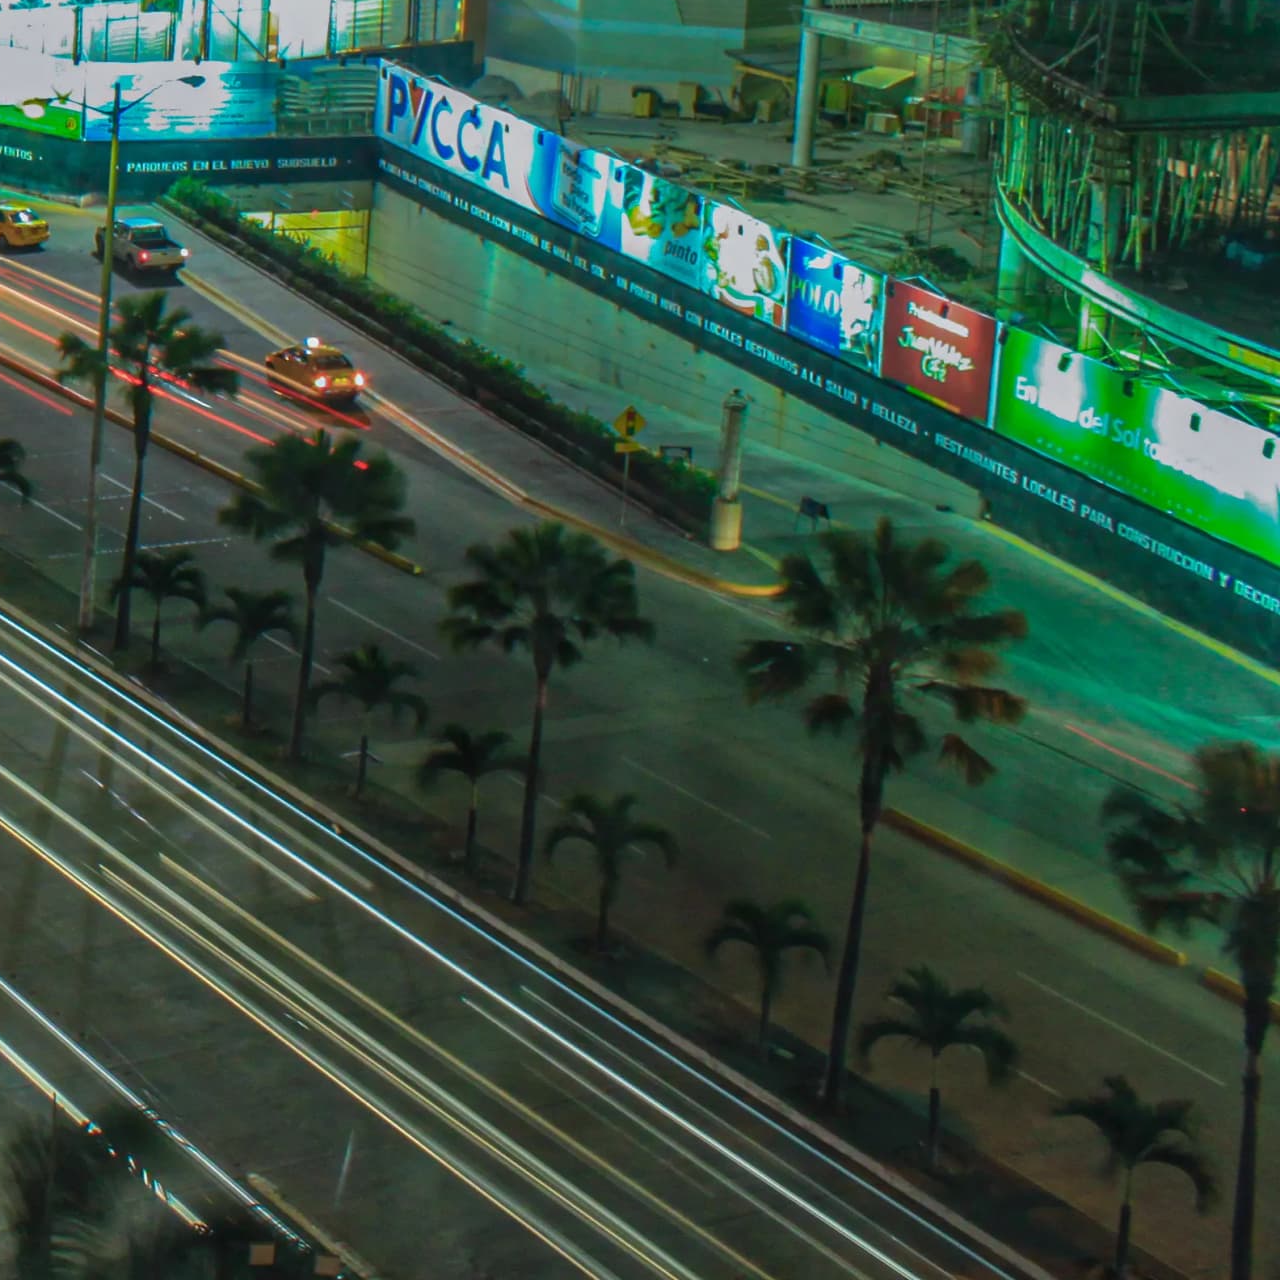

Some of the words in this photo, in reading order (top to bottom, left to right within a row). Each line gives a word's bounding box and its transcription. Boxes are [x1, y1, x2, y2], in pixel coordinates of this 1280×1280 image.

[385, 71, 510, 190] PYCCA
[192, 160, 209, 171] EN
[212, 159, 227, 171] EL
[231, 159, 269, 170] NUEVO
[663, 238, 698, 266] pinto
[791, 273, 841, 318] POLO
[704, 316, 742, 349] LOCALES
[808, 369, 822, 389] LA
[824, 377, 856, 406] SALUD
[871, 399, 917, 436] BELLEZA
[934, 429, 1018, 486] RESTAURANTES
[1022, 473, 1075, 514] LOCALES
[1080, 502, 1114, 534] PARA
[1116, 520, 1213, 582] CONSTRUCCION
[1079, 407, 1109, 437] del
[1111, 418, 1141, 449] Sol
